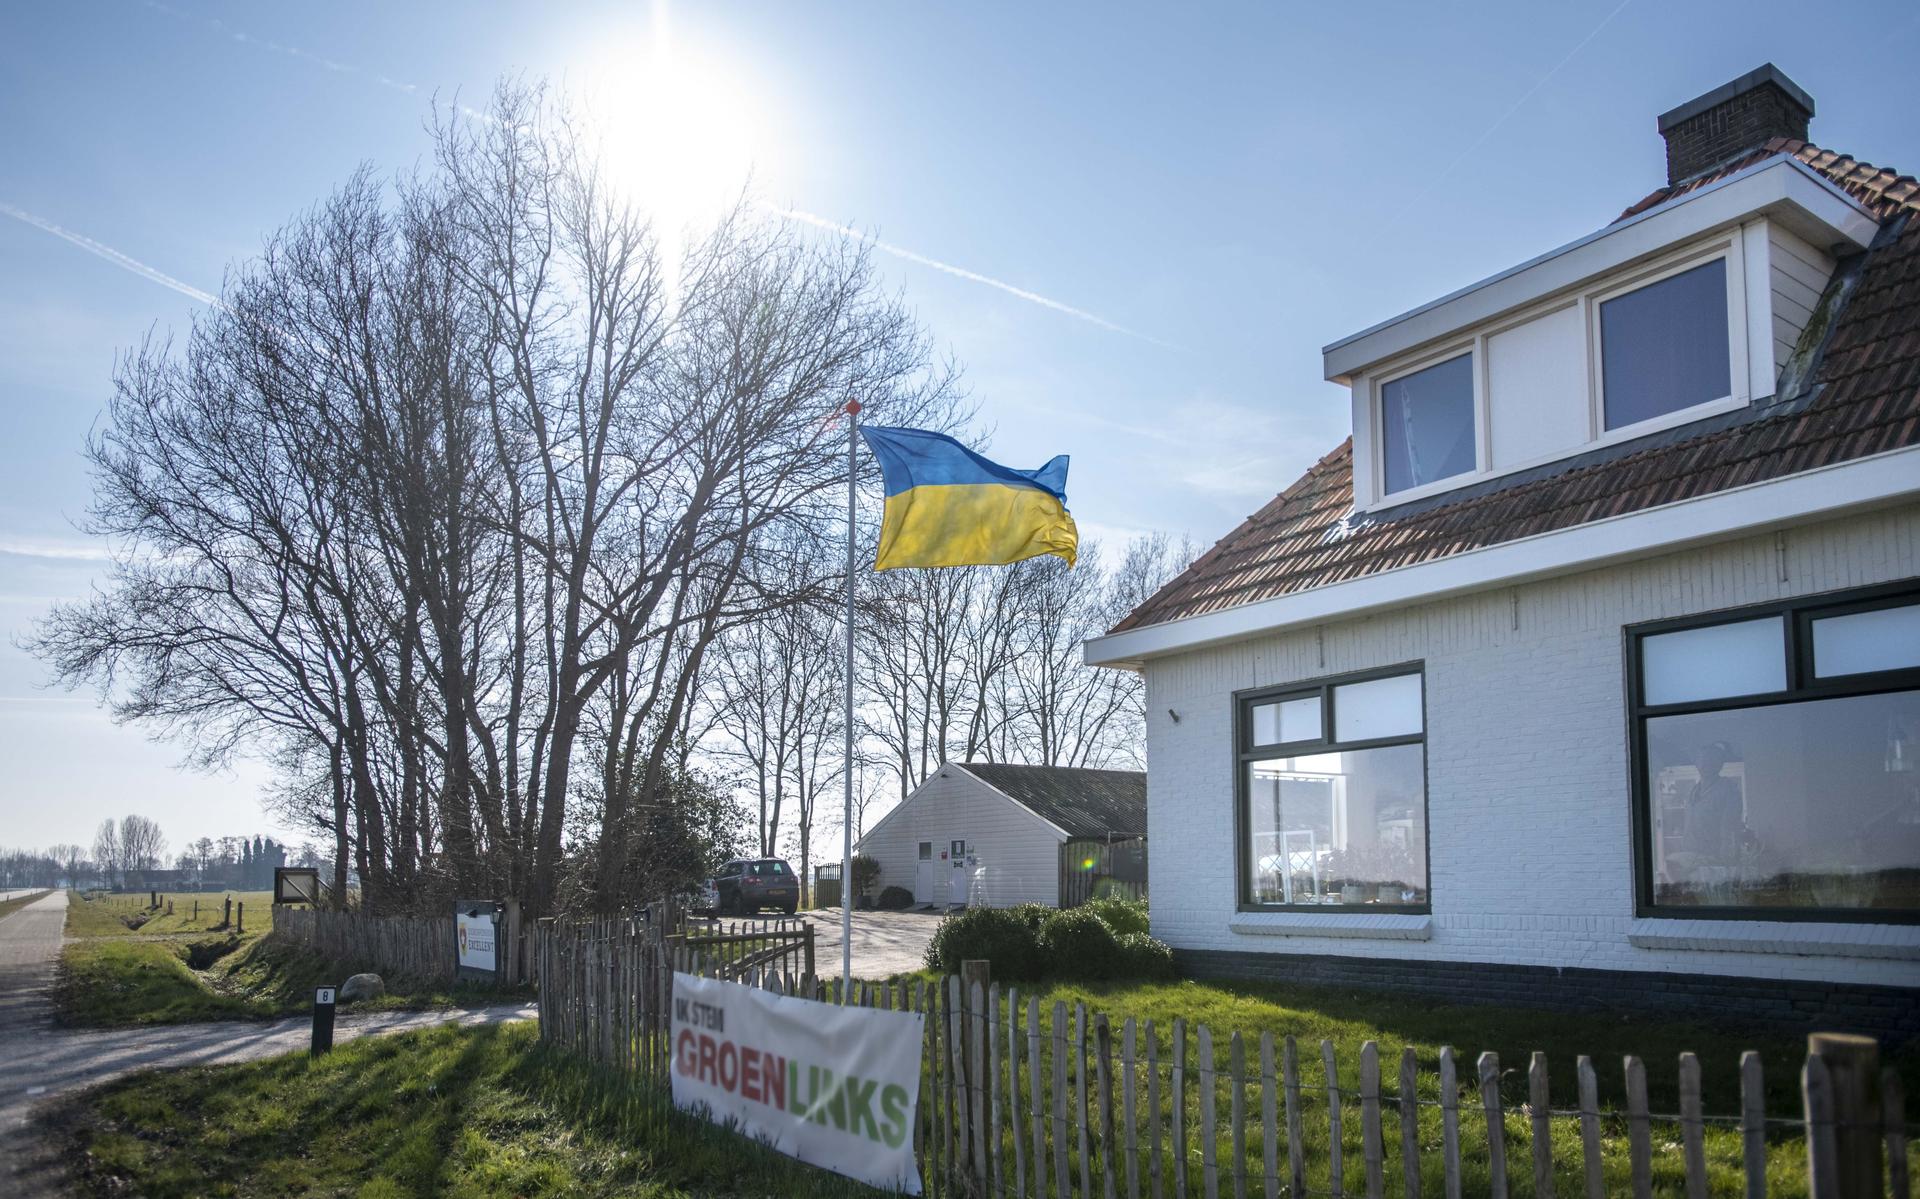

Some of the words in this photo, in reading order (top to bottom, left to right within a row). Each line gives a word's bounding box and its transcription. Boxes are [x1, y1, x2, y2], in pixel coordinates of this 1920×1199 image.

[468, 939, 494, 952] EXCELLENT
[322, 990, 329, 1002] 8
[676, 998, 689, 1022] IK
[692, 1001, 724, 1032] STEM
[677, 1028, 909, 1148] GROENLINKS
